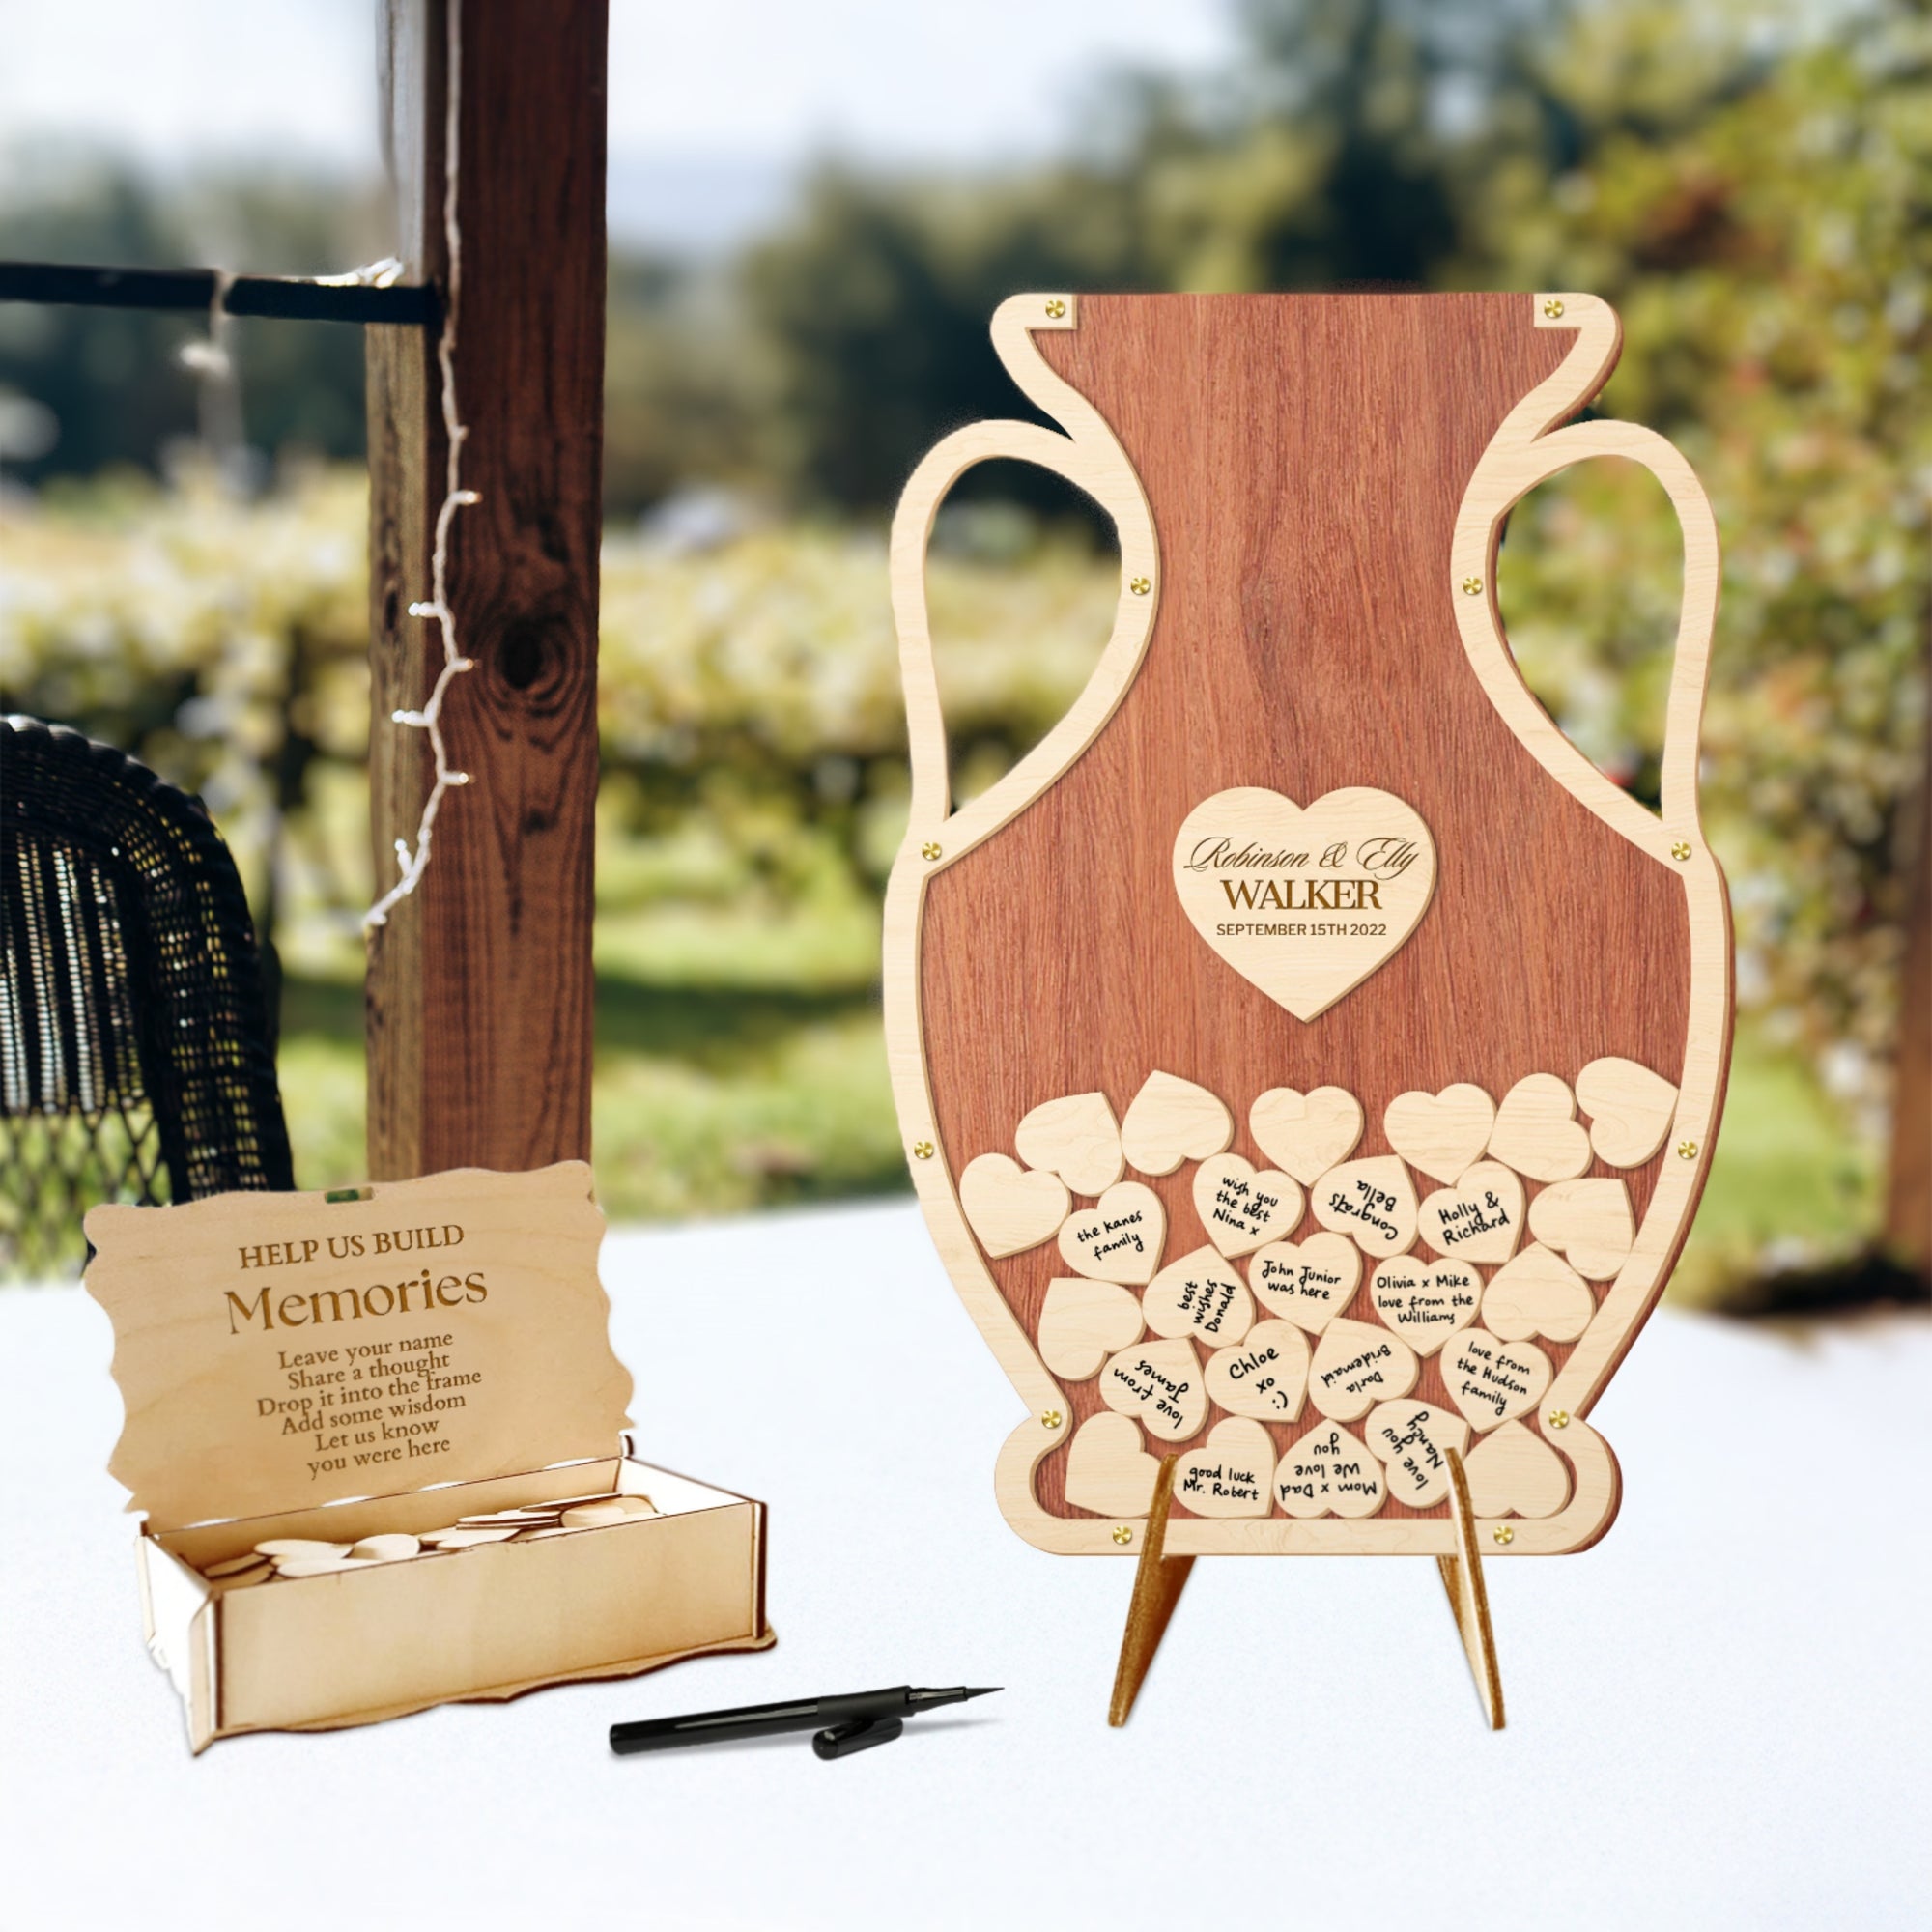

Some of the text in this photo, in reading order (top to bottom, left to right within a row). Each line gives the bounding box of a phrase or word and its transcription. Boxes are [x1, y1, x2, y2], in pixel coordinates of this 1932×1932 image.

[1183, 837, 1421, 880] Robinson & Elly
[1220, 879, 1382, 910] WALKER
[1217, 924, 1386, 936] SEPTEMBER 15TH 2022
[1216, 1190, 1271, 1222] the best
[1222, 1177, 1278, 1208] wish you
[1357, 1180, 1396, 1211] Bella
[1438, 1192, 1499, 1225] Holly &
[1077, 1211, 1143, 1243] the kanes
[1213, 1208, 1260, 1236] Nina x
[1329, 1193, 1398, 1239] Congrats
[1443, 1208, 1510, 1245] Richard
[239, 1224, 465, 1269] HELP US BUILD
[1094, 1233, 1144, 1260] family
[1262, 1261, 1342, 1285] John Junior
[1378, 1276, 1416, 1288] Olivia
[1436, 1275, 1469, 1287] Mike
[224, 1269, 488, 1334] Memories
[1178, 1281, 1198, 1310] best
[1193, 1279, 1217, 1324] wishes
[1268, 1282, 1330, 1300] was here
[1378, 1294, 1473, 1312] love from the
[1205, 1284, 1236, 1332] Donald
[1398, 1311, 1455, 1324] Williams
[278, 1334, 453, 1369] Leave your name
[1230, 1348, 1279, 1379] Chloe
[1321, 1344, 1391, 1388] Bridemaid
[1468, 1341, 1530, 1375] love from
[288, 1351, 450, 1389] Share a thought
[1135, 1360, 1189, 1403] James
[1256, 1377, 1275, 1393] xo
[1457, 1358, 1527, 1395] the Hudson
[257, 1371, 482, 1417] Drop it into the frame
[1114, 1368, 1183, 1429] love from
[1462, 1381, 1507, 1416] family
[281, 1395, 466, 1435] Add some wisdom
[315, 1420, 440, 1451] Let us know
[1314, 1433, 1339, 1455] you
[1407, 1411, 1443, 1470] Nancy
[307, 1438, 450, 1480] you were here
[1189, 1464, 1255, 1483] good luck
[1294, 1463, 1360, 1477] We love
[1382, 1428, 1429, 1490] love you
[1183, 1479, 1259, 1500] Mr. Robert
[1281, 1481, 1377, 1501] Mom x Dad
